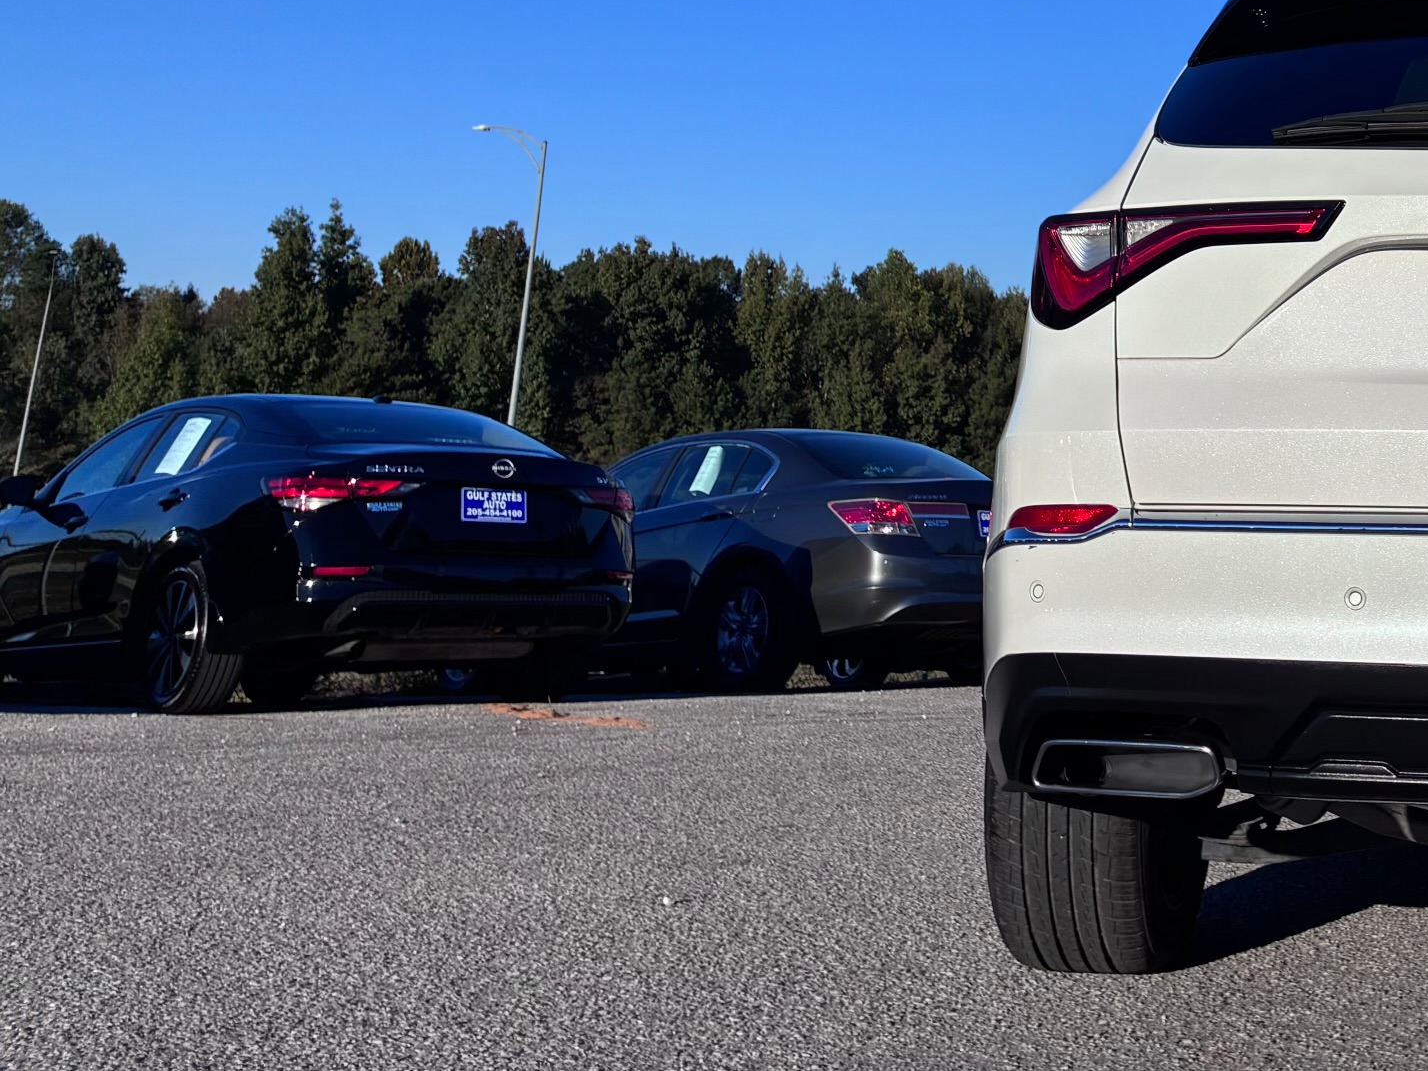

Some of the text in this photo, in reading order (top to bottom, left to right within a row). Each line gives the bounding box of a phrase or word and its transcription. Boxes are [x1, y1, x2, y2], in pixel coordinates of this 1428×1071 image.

[366, 464, 425, 474] SENTRA
[466, 490, 522, 503] GULF STATES
[482, 499, 507, 510] AUTO
[466, 507, 523, 518] 205-454-4100
